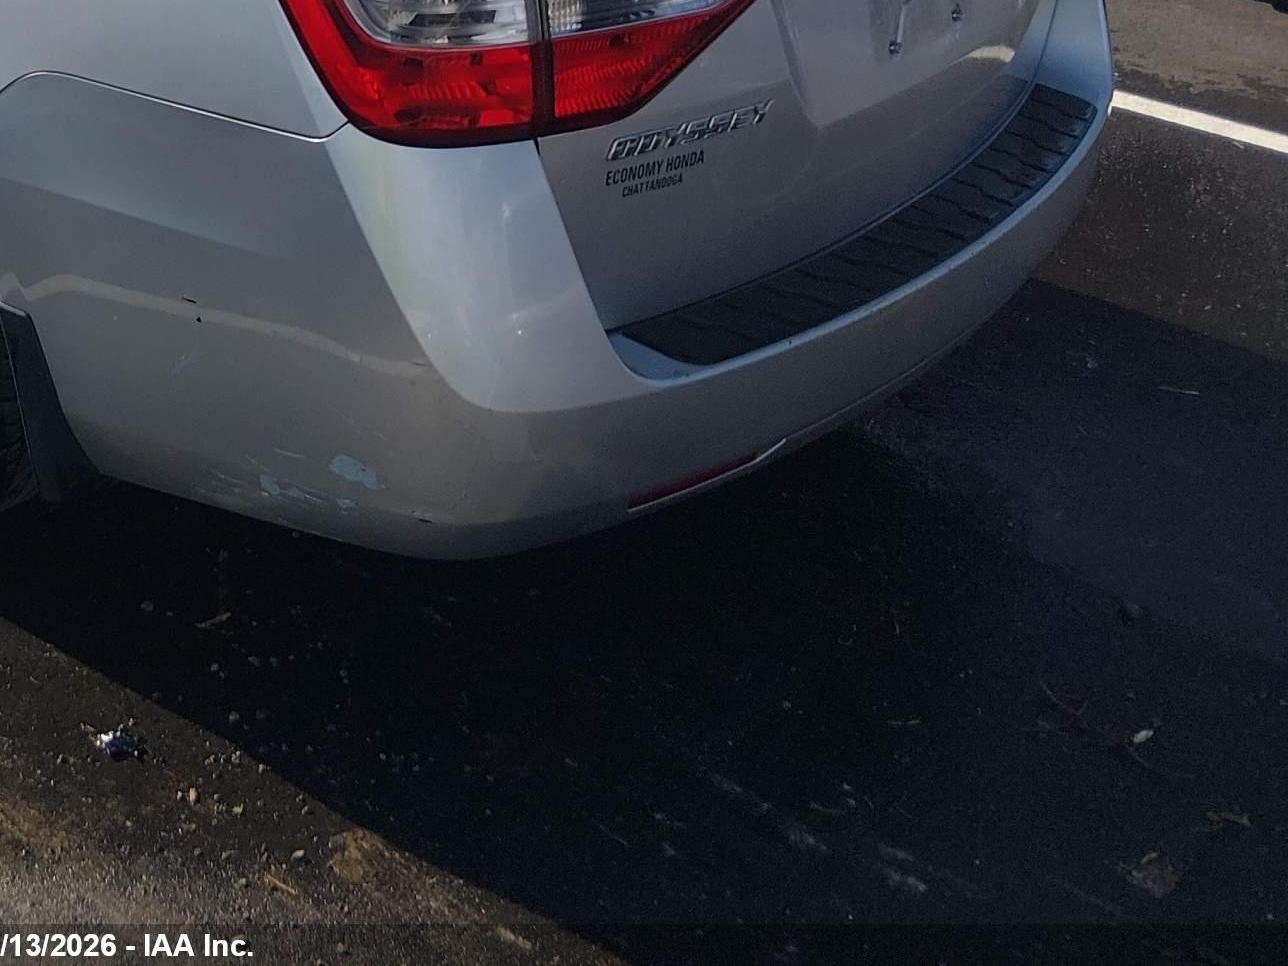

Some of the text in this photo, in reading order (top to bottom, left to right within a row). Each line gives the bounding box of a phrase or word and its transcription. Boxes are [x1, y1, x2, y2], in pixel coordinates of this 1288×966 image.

[606, 99, 775, 161] ODYSSEY
[605, 149, 705, 186] ECONOMY HONDA
[622, 173, 683, 198] CHATTANOOGA
